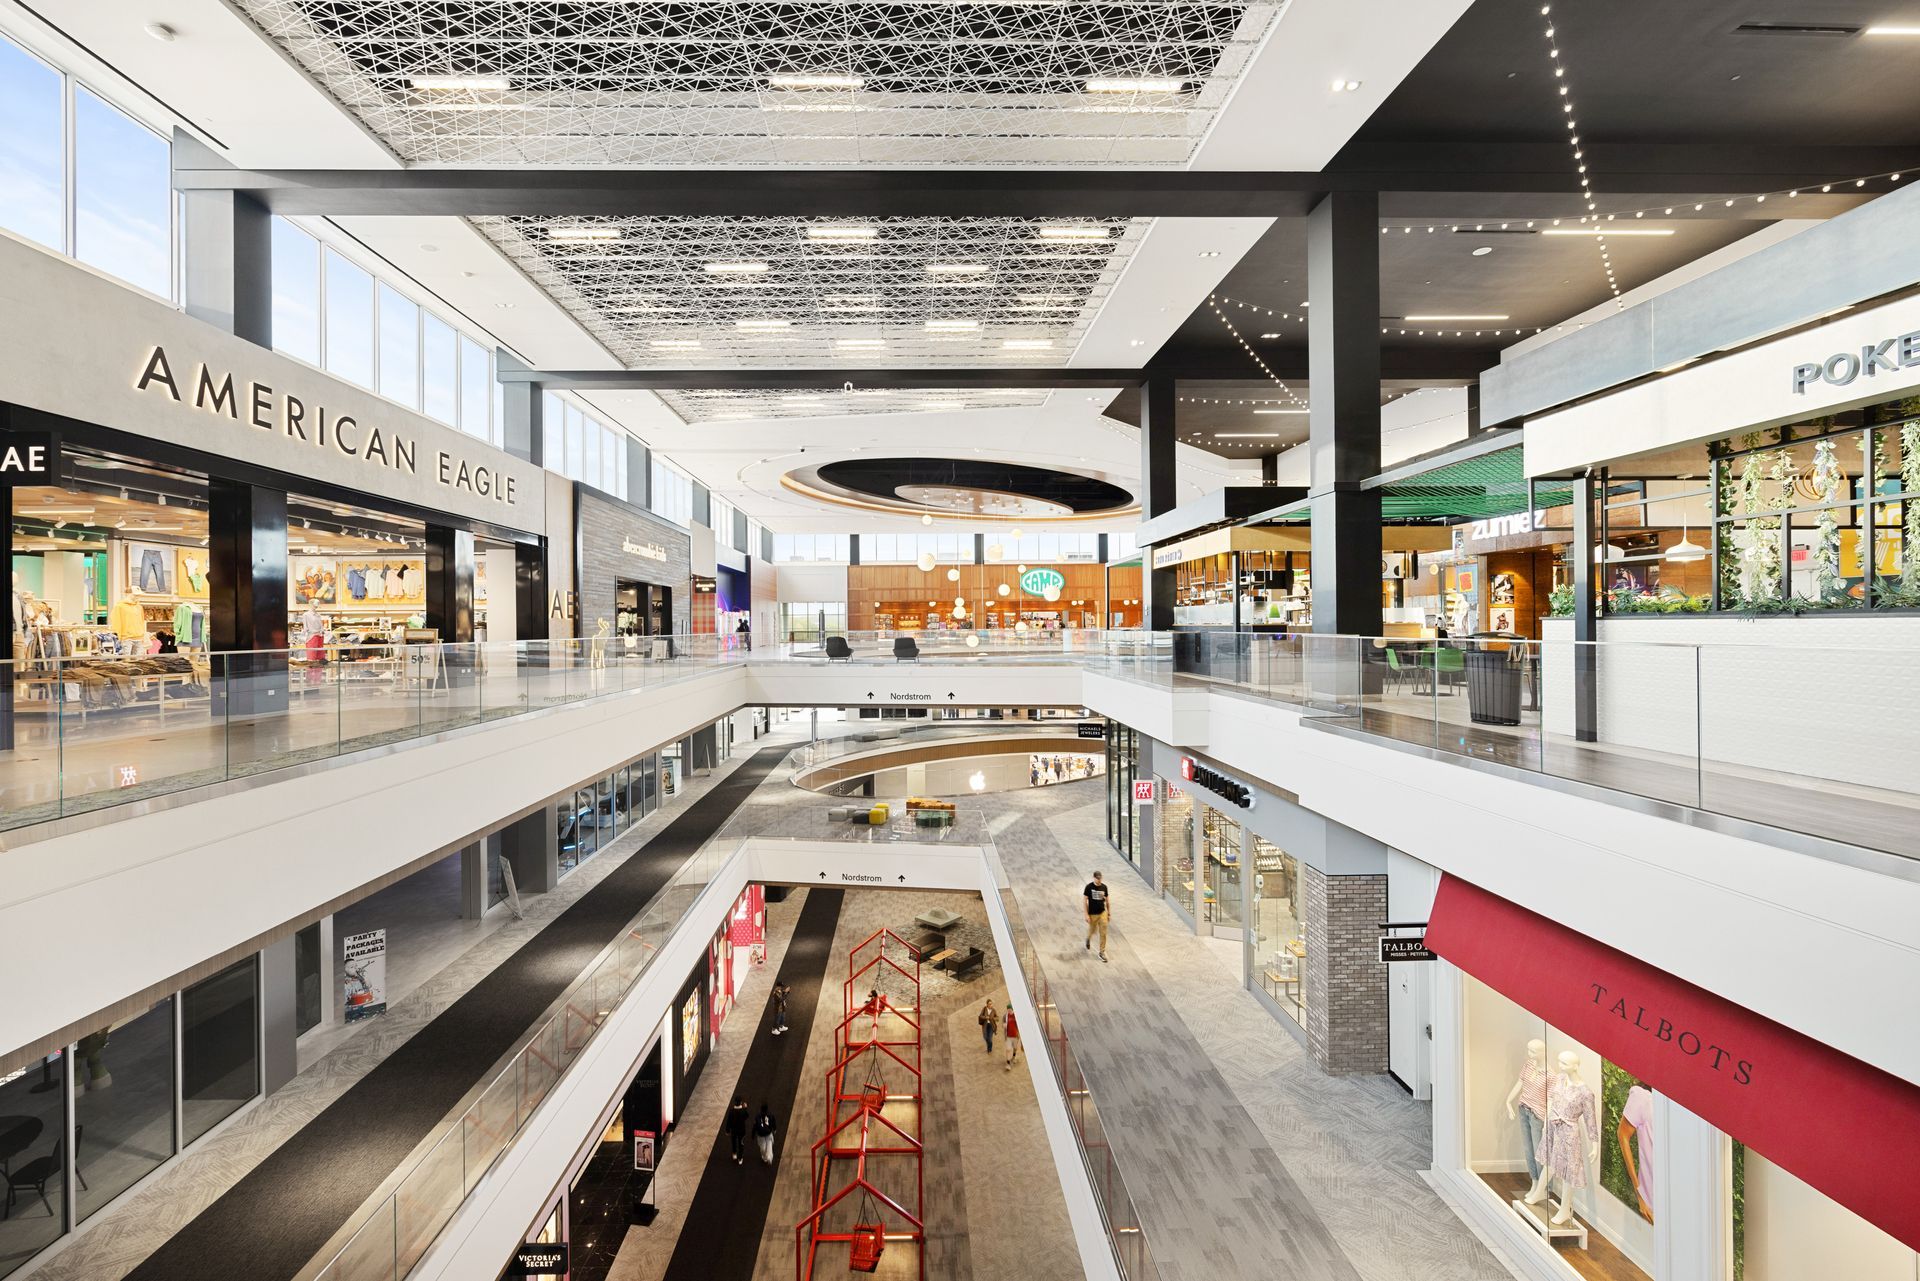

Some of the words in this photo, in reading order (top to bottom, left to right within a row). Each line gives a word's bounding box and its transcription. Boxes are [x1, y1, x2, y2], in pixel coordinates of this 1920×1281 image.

[1792, 329, 1920, 395] POKE
[137, 345, 417, 474] AMERICAN
[438, 452, 516, 505] EAGLE
[0, 446, 46, 472] AE
[1472, 509, 1546, 541] zumiez
[551, 589, 574, 619] AE
[890, 692, 932, 701] Nordstrom
[842, 873, 882, 882] Nordstrom
[352, 931, 378, 942] PARTY
[346, 938, 384, 951] PACKAGES
[1383, 942, 1428, 952] TALBO
[345, 945, 385, 960] AVAILABLE
[1591, 983, 1753, 1085] TALBOTS
[518, 1254, 562, 1262] VICTORIA'S
